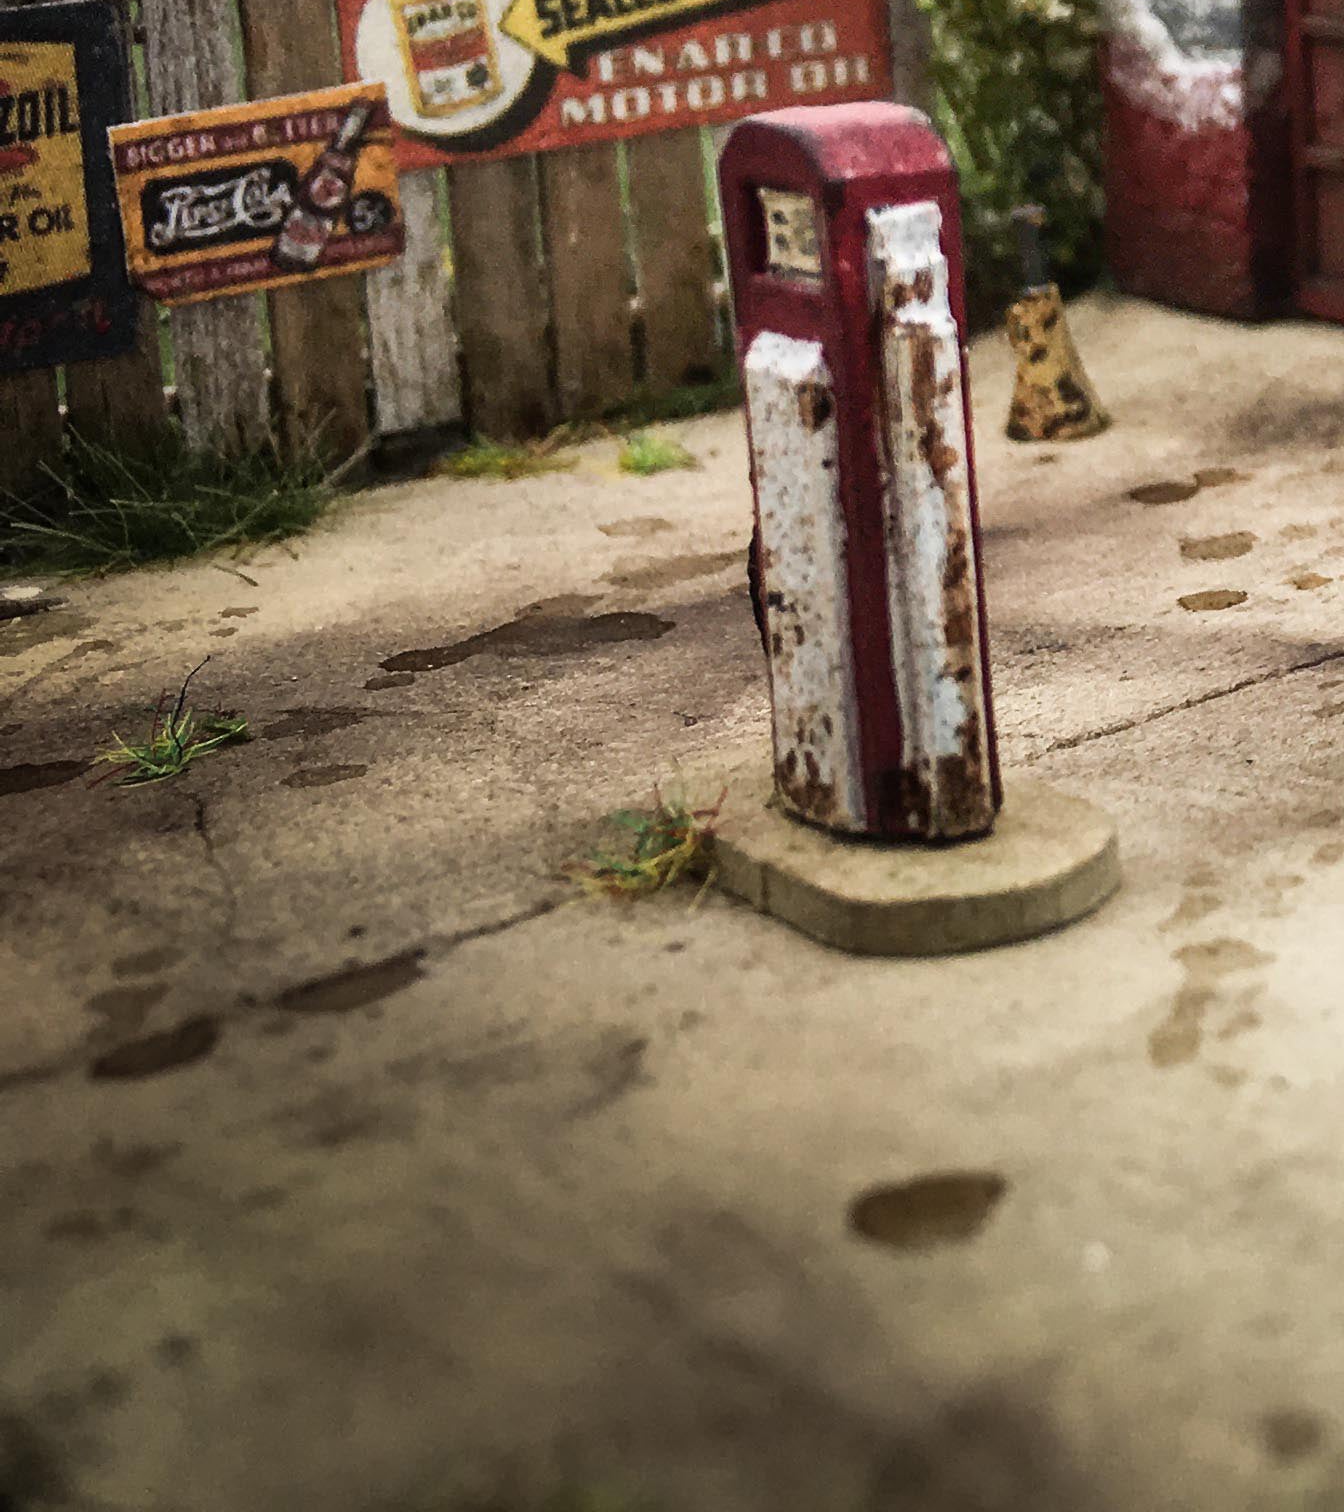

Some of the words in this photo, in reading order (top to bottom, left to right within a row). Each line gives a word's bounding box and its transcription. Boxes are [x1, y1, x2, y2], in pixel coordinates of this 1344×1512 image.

[560, 69, 768, 128] MOTOR
[789, 54, 871, 95] OIL
[125, 134, 216, 167] BIGGER
